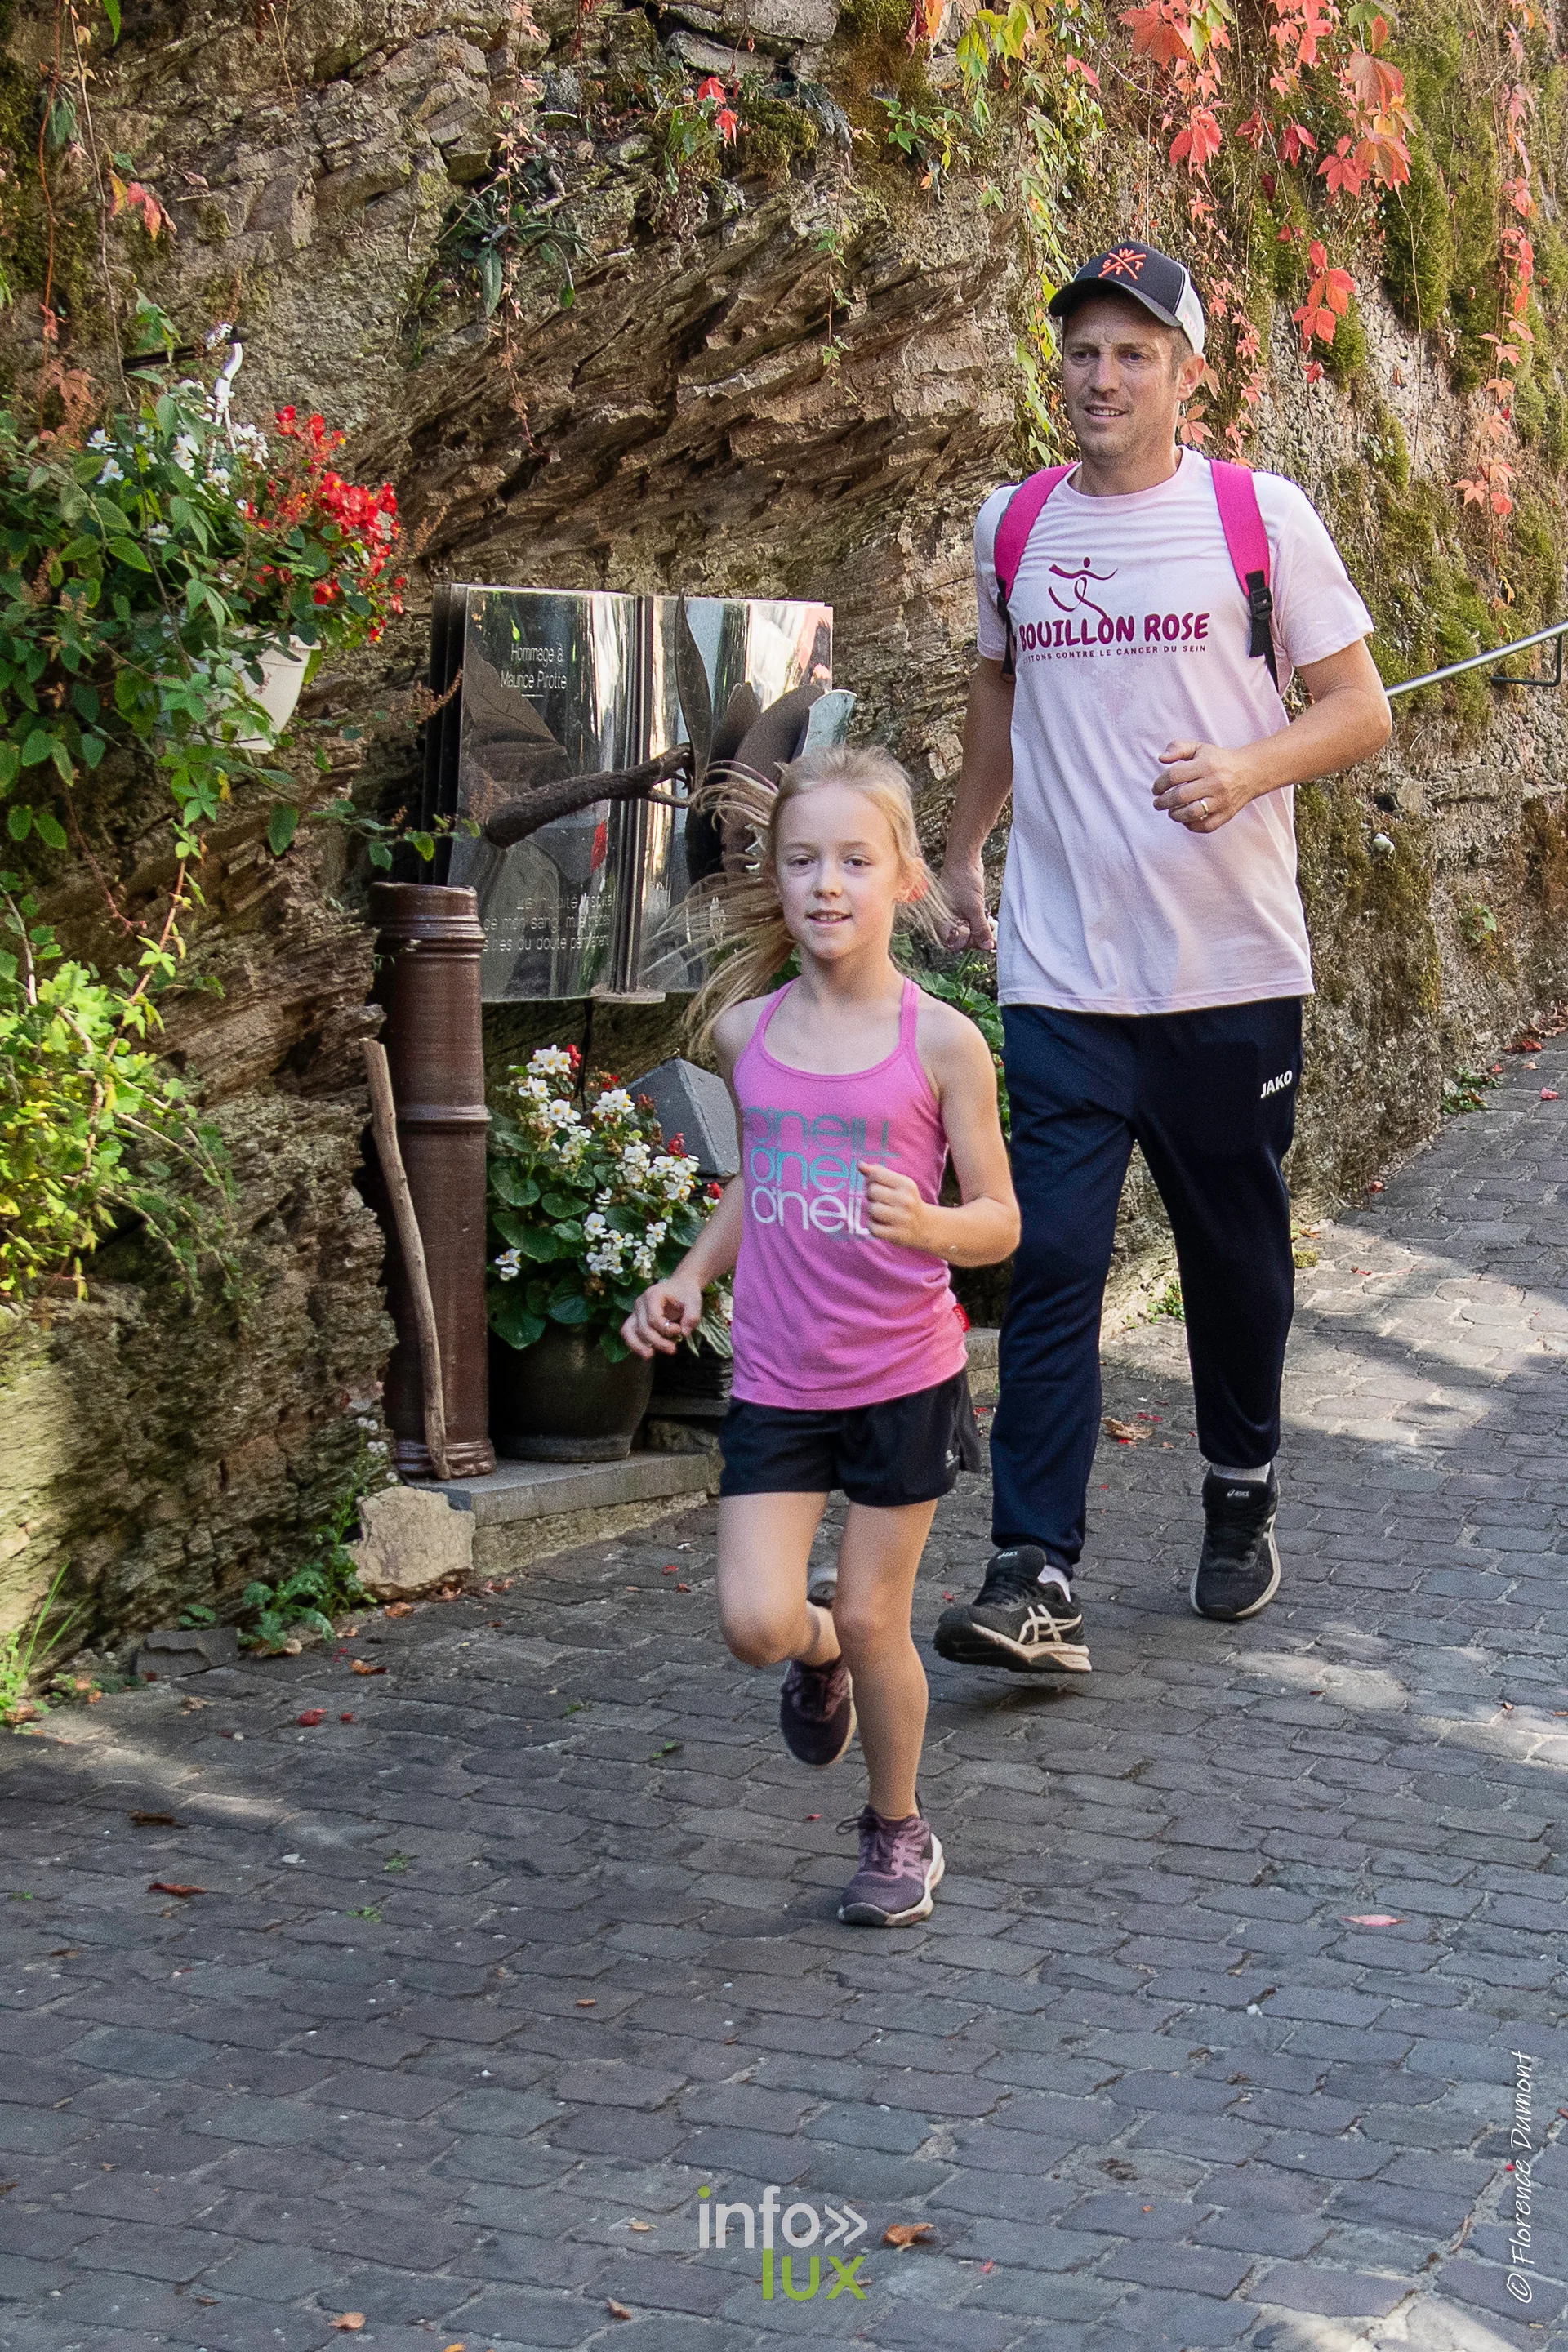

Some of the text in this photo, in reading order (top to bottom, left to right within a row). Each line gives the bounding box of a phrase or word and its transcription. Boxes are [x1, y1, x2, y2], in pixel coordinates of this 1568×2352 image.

[1019, 612, 1210, 652] BOUILLON ROSE
[510, 643, 555, 667] Hommage
[1056, 649, 1094, 659] CONTRE
[1116, 646, 1158, 656] CANCER
[501, 670, 535, 688] Maurice
[1260, 1070, 1293, 1098] JAKO
